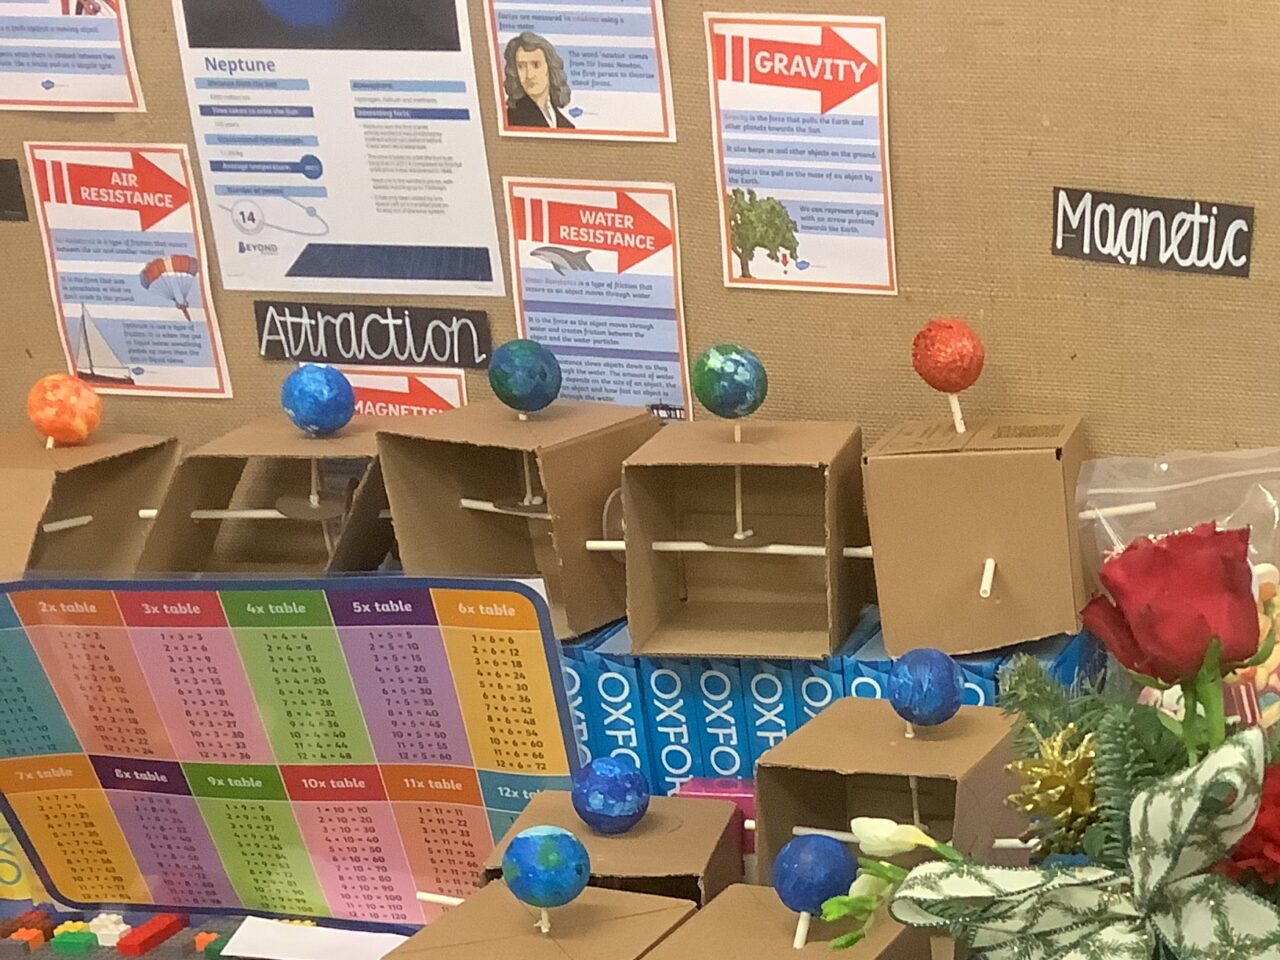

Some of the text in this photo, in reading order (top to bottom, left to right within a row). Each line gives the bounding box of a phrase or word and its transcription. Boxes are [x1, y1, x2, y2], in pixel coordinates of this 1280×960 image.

[204, 56, 276, 75] Neptune
[754, 51, 867, 83] GRAVITY
[110, 171, 138, 187] AIR
[80, 186, 173, 208] RESISTANCE
[239, 210, 256, 224] 14
[579, 210, 634, 229] WATER
[1056, 189, 1249, 270] Magnetic
[560, 226, 655, 250] RESISTANCE
[260, 305, 487, 363] Attraction
[355, 400, 444, 416] MAGNETIS
[38, 602, 97, 614] 2x table
[142, 602, 200, 614] 3x table
[246, 602, 306, 614] 4x table
[352, 600, 412, 613] 5x table
[458, 604, 516, 616] 6x table
[563, 666, 593, 769] OXFO
[751, 672, 788, 748] OXF
[598, 671, 642, 769] OXFO
[700, 669, 742, 777] OXFO
[16, 768, 73, 781] 7x table
[114, 768, 168, 782] 8x table
[208, 776, 263, 789] 9x table
[302, 778, 366, 789] 10x table
[403, 778, 462, 791] 11x table
[497, 786, 520, 798] 12x
